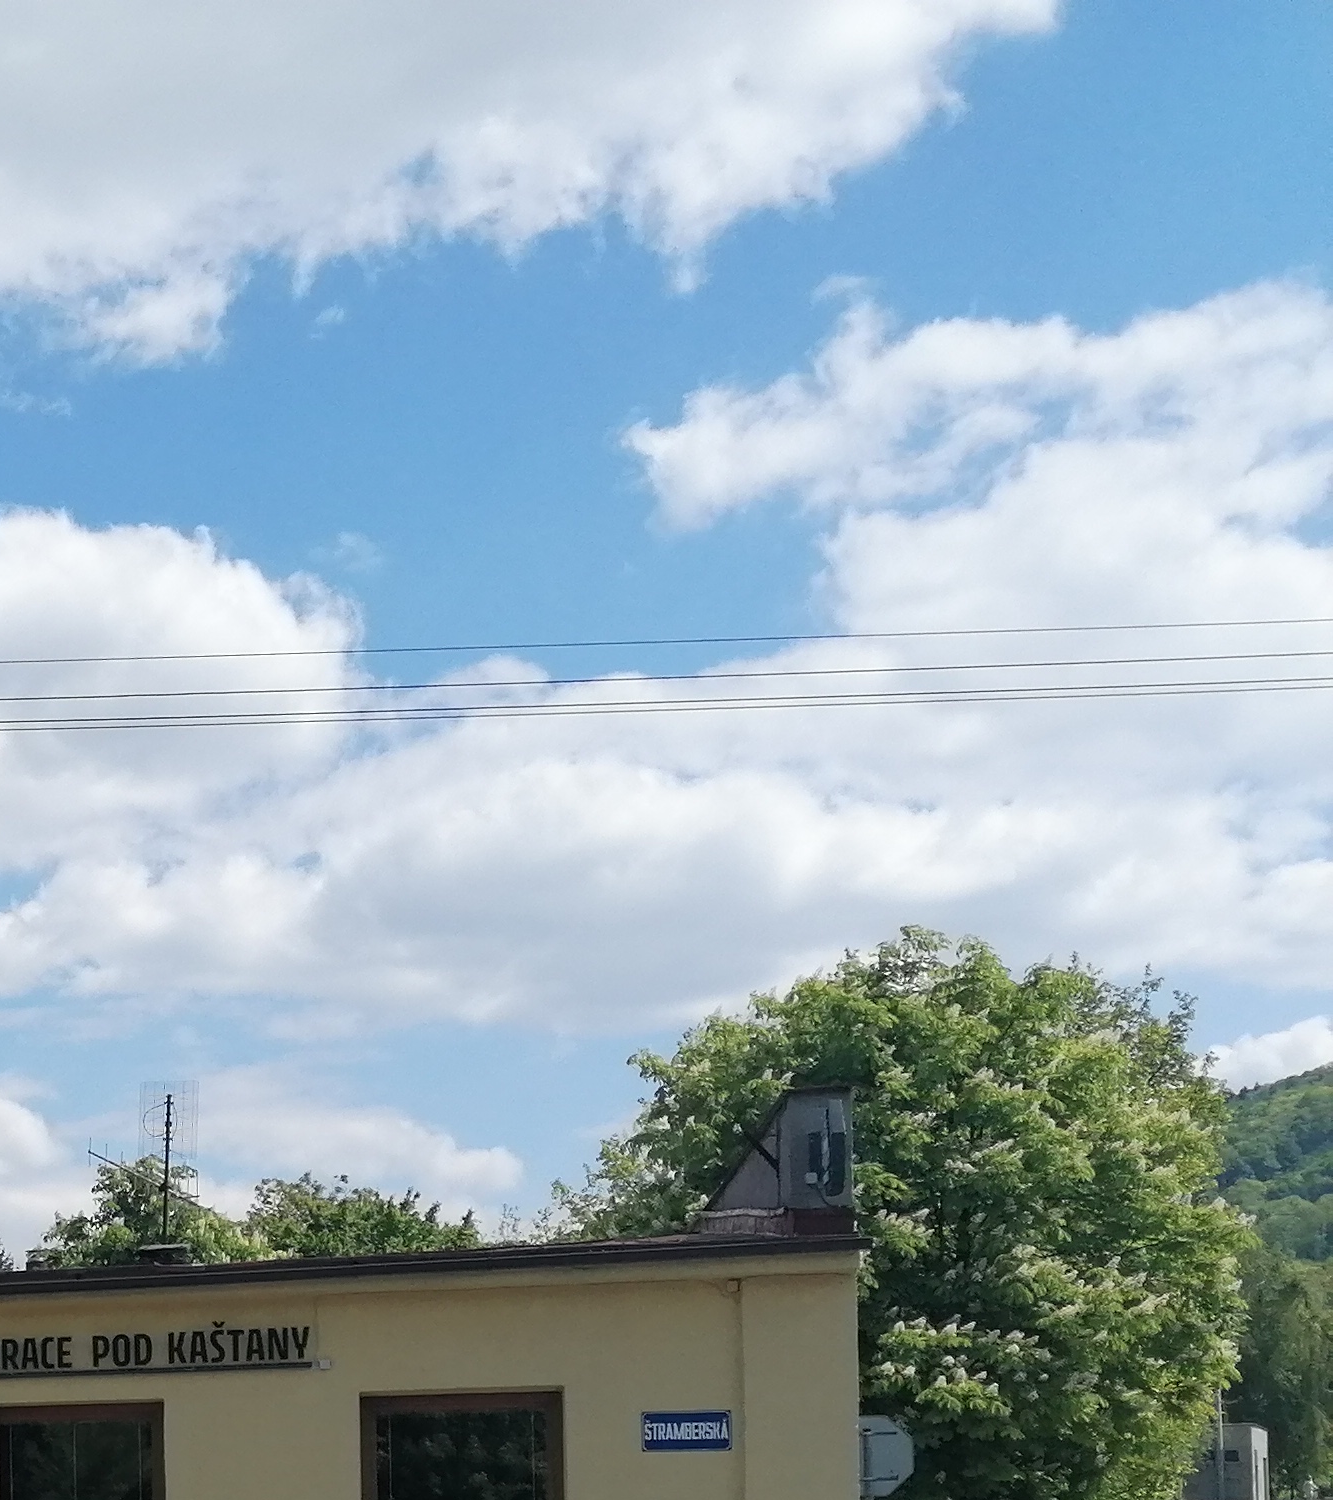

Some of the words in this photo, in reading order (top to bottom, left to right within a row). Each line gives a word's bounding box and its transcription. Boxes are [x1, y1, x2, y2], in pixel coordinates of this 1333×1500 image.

[92, 1334, 153, 1367] POD
[167, 1320, 310, 1364] KAŠTANY
[644, 1418, 729, 1441] ŠTRAMBERSKÁ
